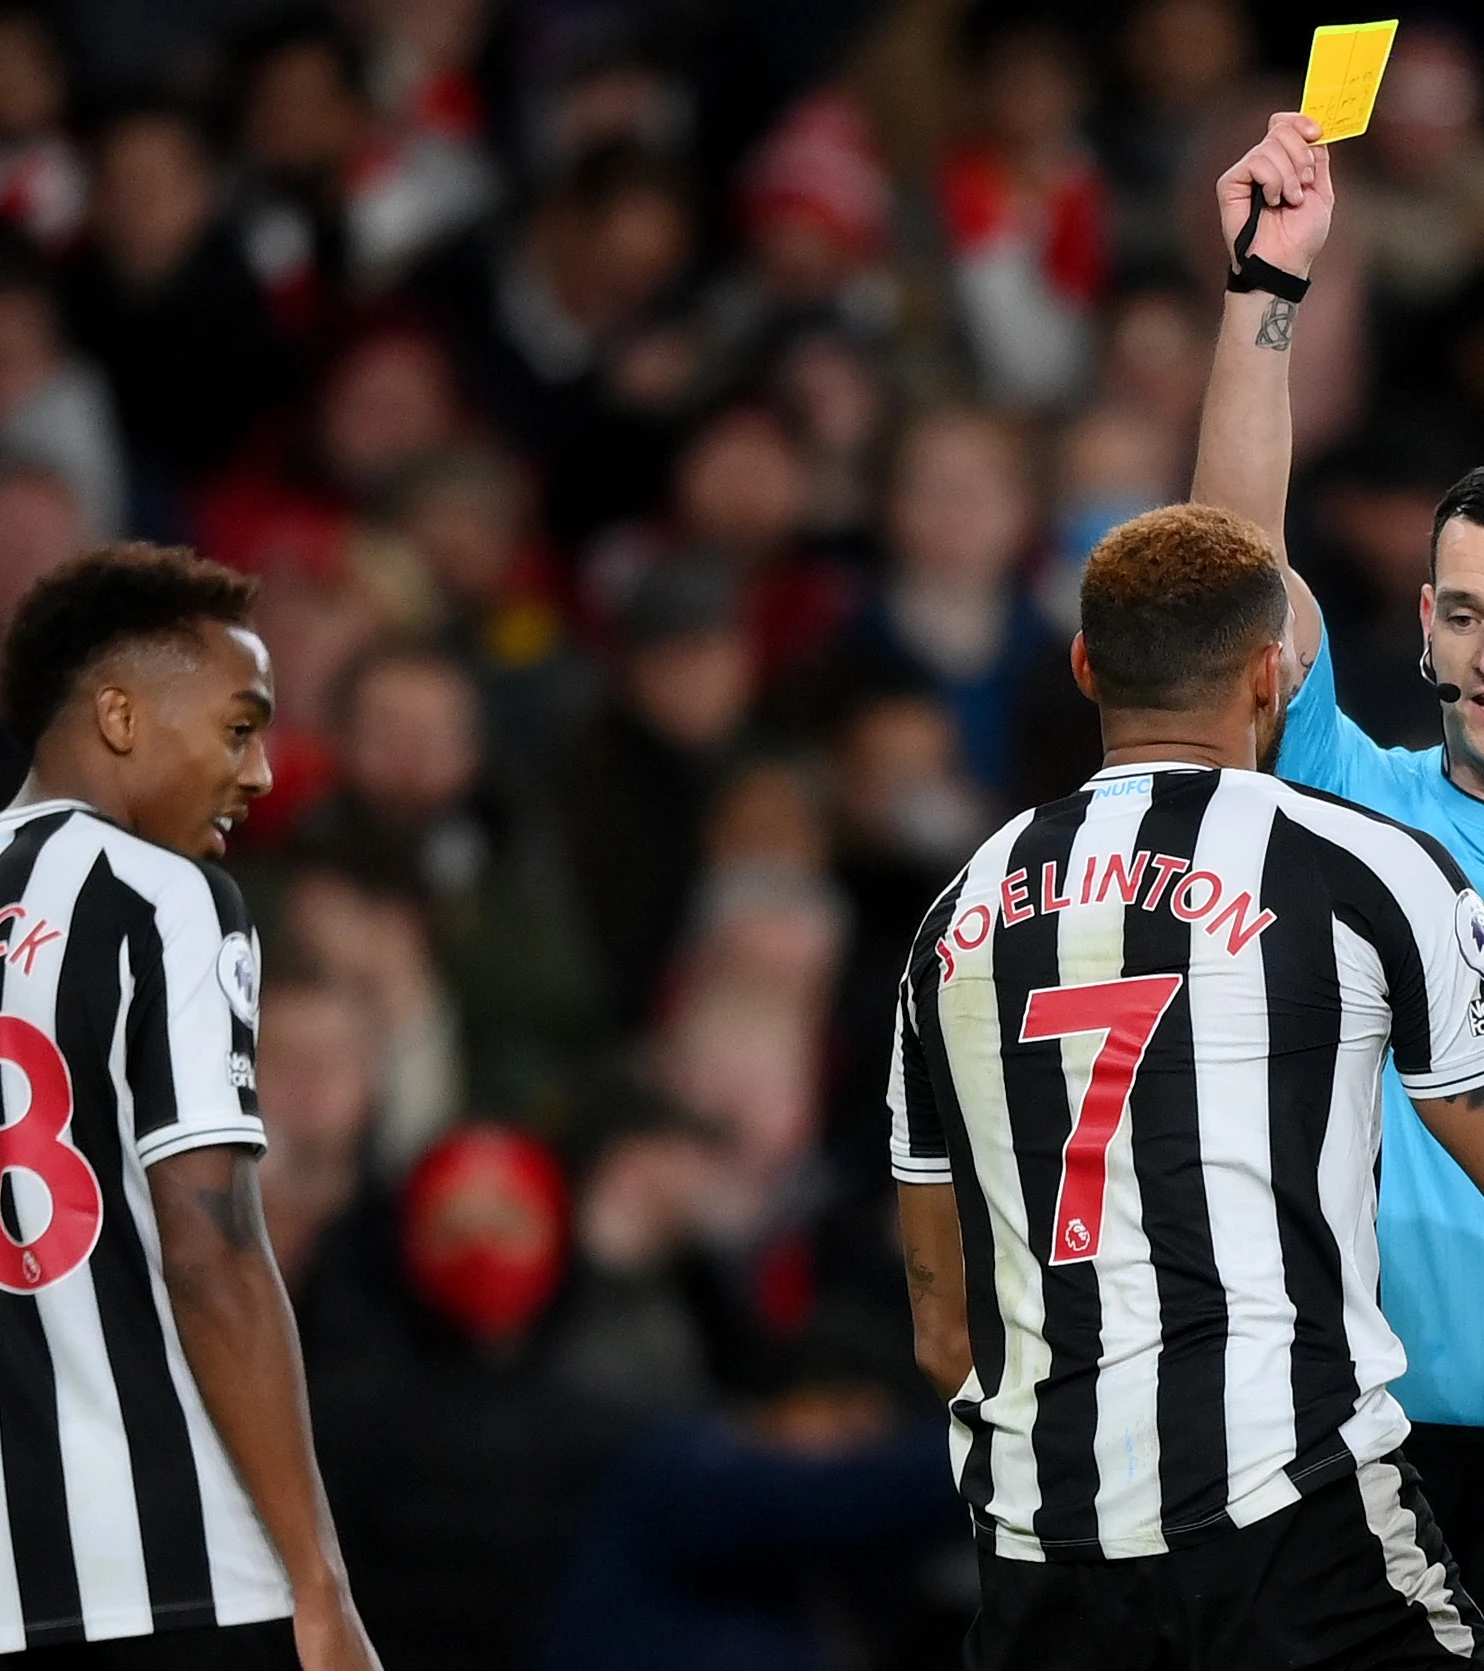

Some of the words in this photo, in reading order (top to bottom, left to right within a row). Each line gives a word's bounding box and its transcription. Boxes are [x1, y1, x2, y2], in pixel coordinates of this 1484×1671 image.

[1096, 777, 1152, 800] NUFC
[935, 849, 1278, 983] JOELINTON
[1018, 973, 1184, 1267] 7
